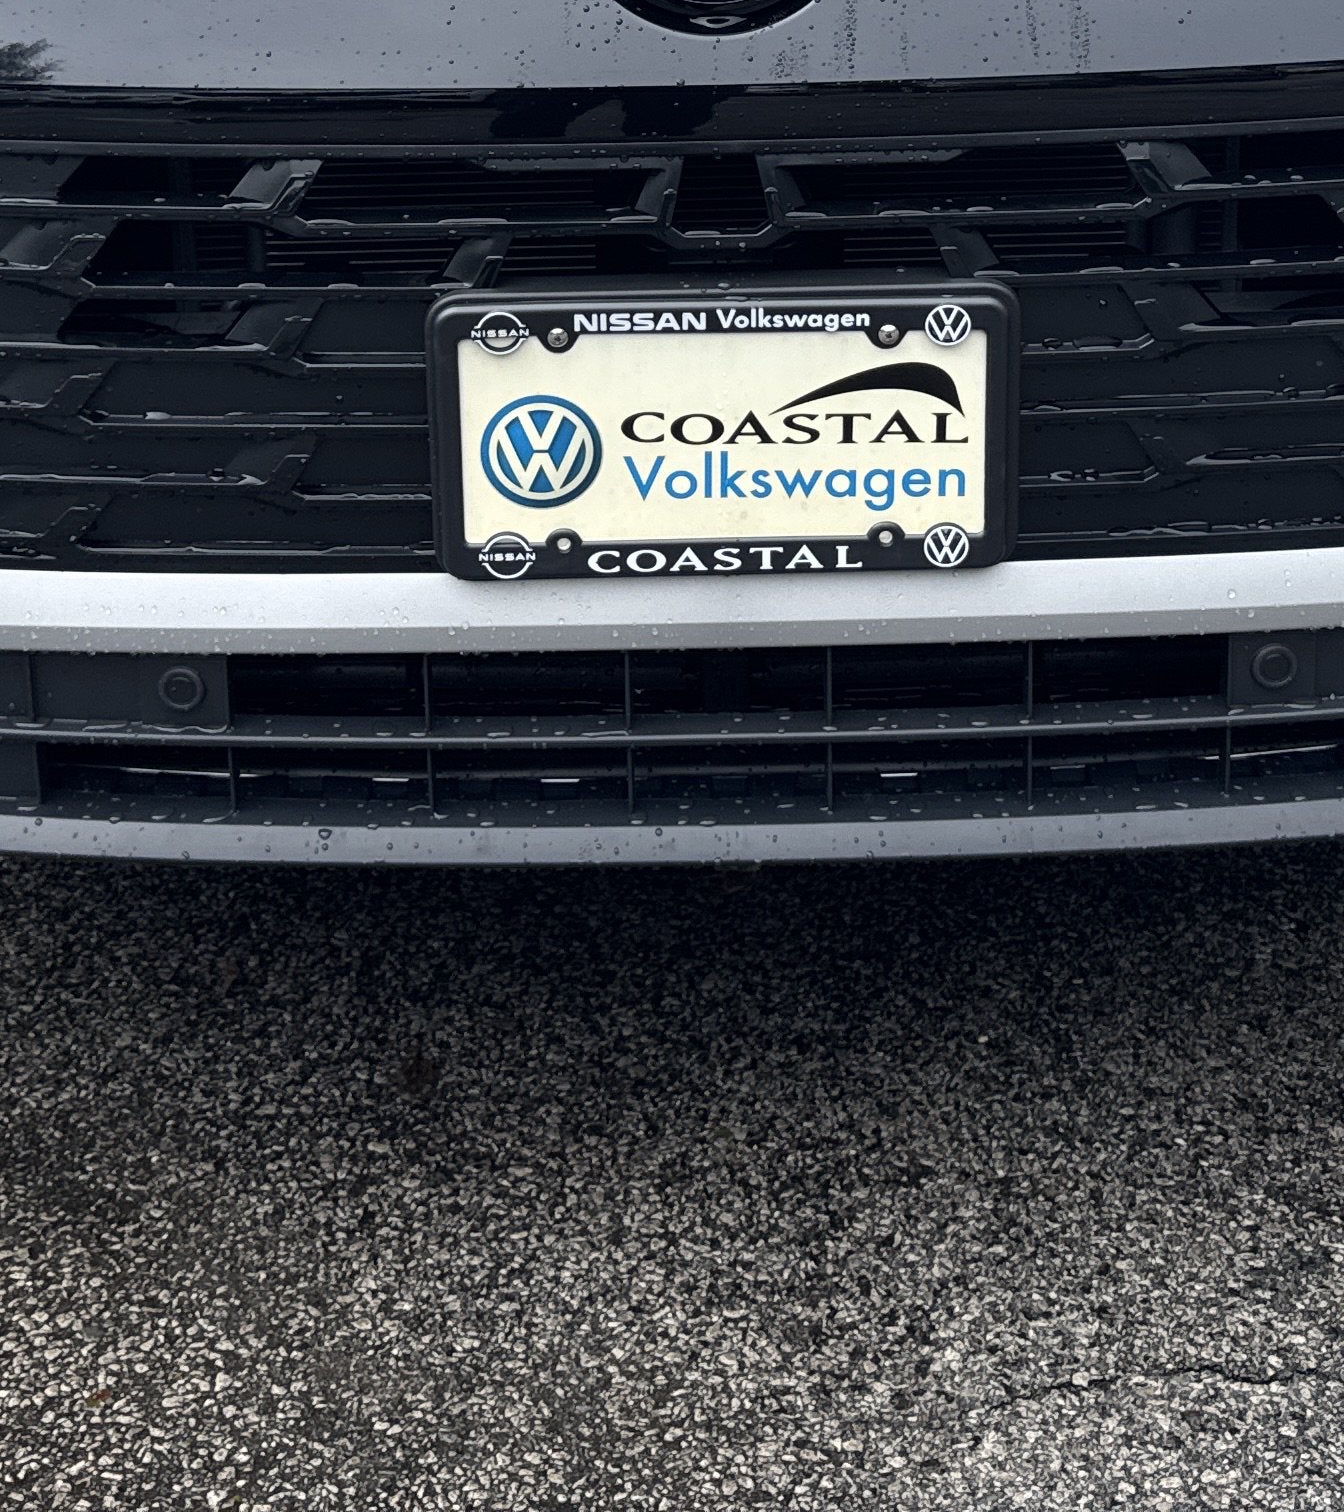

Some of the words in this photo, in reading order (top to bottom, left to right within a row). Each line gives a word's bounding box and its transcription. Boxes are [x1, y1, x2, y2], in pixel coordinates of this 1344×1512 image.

[470, 328, 530, 339] NISSAN
[573, 312, 707, 333] NISSAN
[715, 307, 871, 331] Volkswagen
[620, 408, 969, 445] COASTAL
[623, 450, 966, 512] Volkswagen
[478, 552, 536, 562] NISSAN
[587, 544, 863, 574] COASTAL
